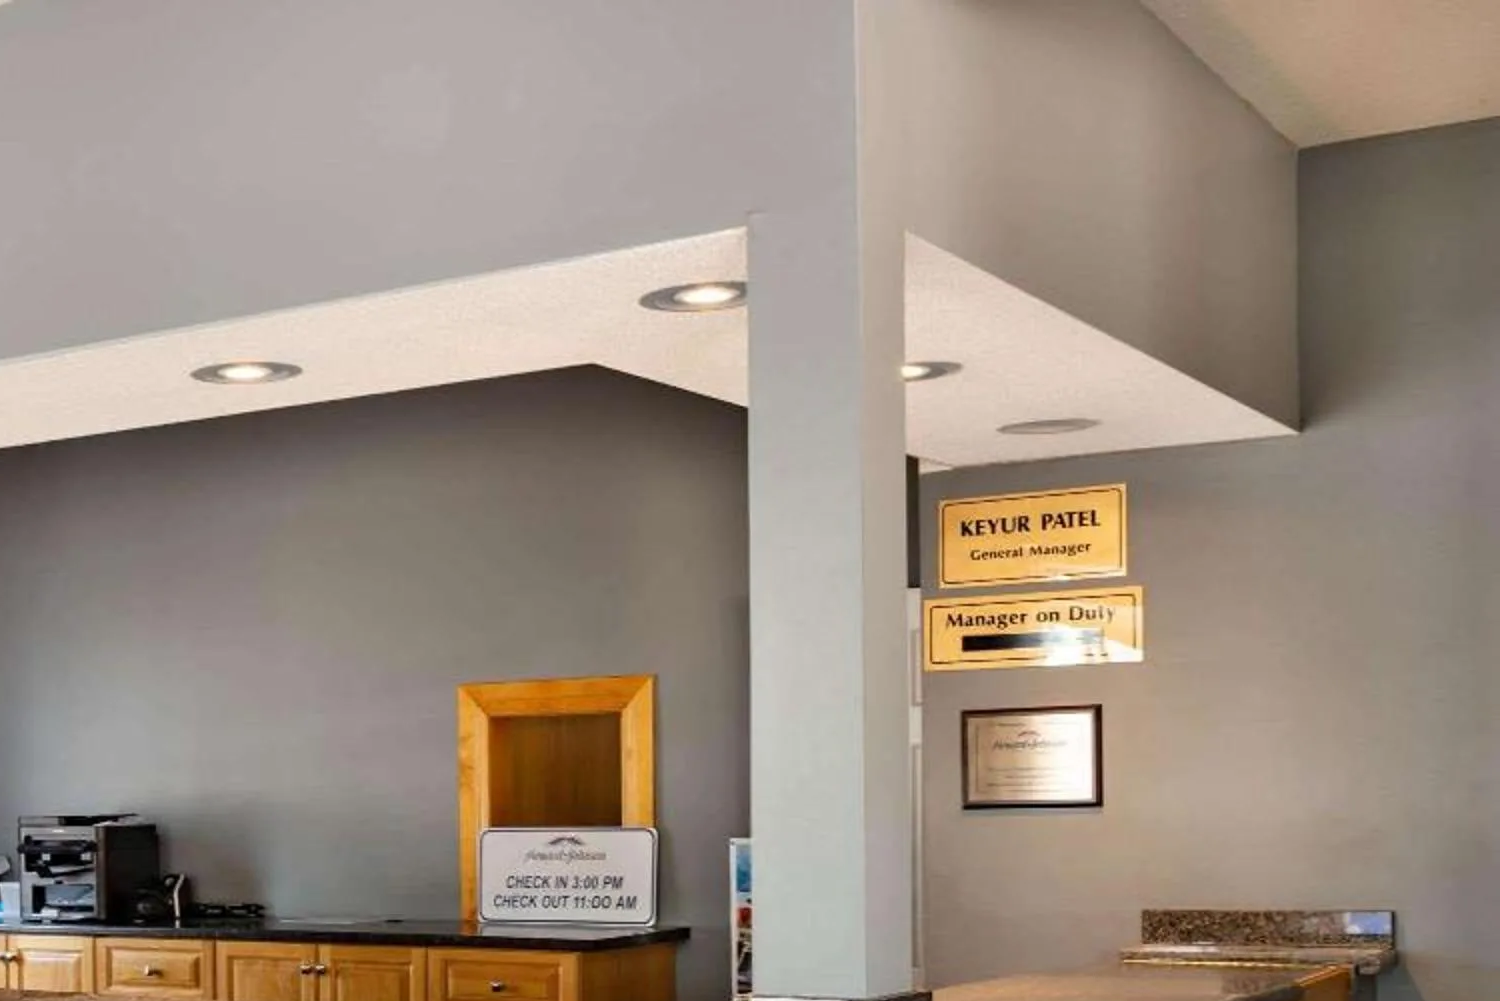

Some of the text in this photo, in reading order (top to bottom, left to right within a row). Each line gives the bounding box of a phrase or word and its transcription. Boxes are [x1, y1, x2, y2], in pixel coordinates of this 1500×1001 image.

[961, 510, 1101, 536] KEYUR PATEL
[970, 542, 1091, 560] General Manager
[946, 604, 1115, 629] Manager on Duty
[506, 875, 624, 889] CHECK IN 3:00 PM
[493, 895, 537, 909] CHECK
[541, 895, 569, 909] OUT
[615, 895, 638, 910] AM
